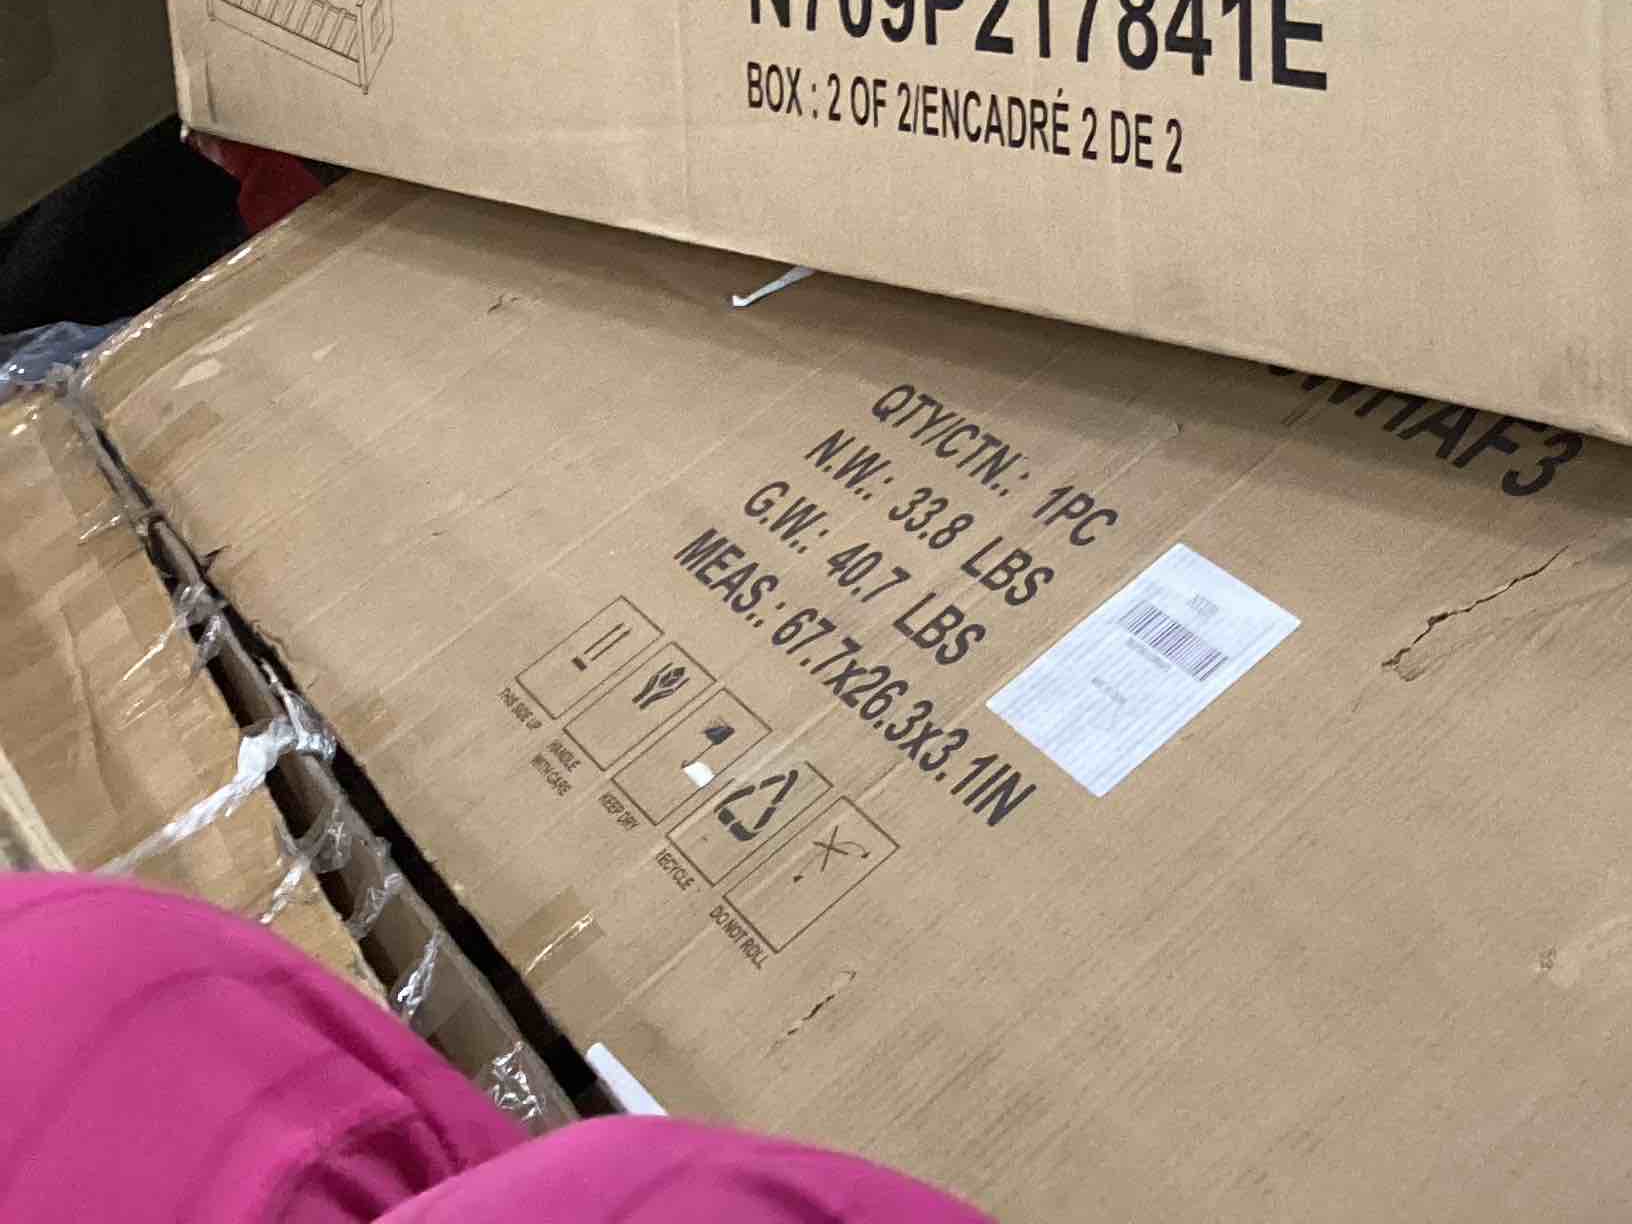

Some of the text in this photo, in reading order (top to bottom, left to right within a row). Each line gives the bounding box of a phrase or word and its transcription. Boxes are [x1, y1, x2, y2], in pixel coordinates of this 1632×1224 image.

[747, 61, 803, 116] BOX
[827, 73, 842, 122] 2
[850, 75, 887, 128] OF
[897, 82, 1071, 156] 2/ENCADRÉ
[1081, 106, 1098, 160] 2
[1110, 110, 1153, 169] DE
[1166, 118, 1182, 174] 2
[803, 428, 1055, 607] N.W.: 33.8 LBS
[871, 383, 1119, 547] QTY/CTN.: 1PC
[744, 480, 987, 665] G.W.: 40.7 LBS
[673, 527, 1037, 828] MEAS.: 67.7x26.3x3.1IN
[708, 905, 769, 969] DO NOT ROLL
